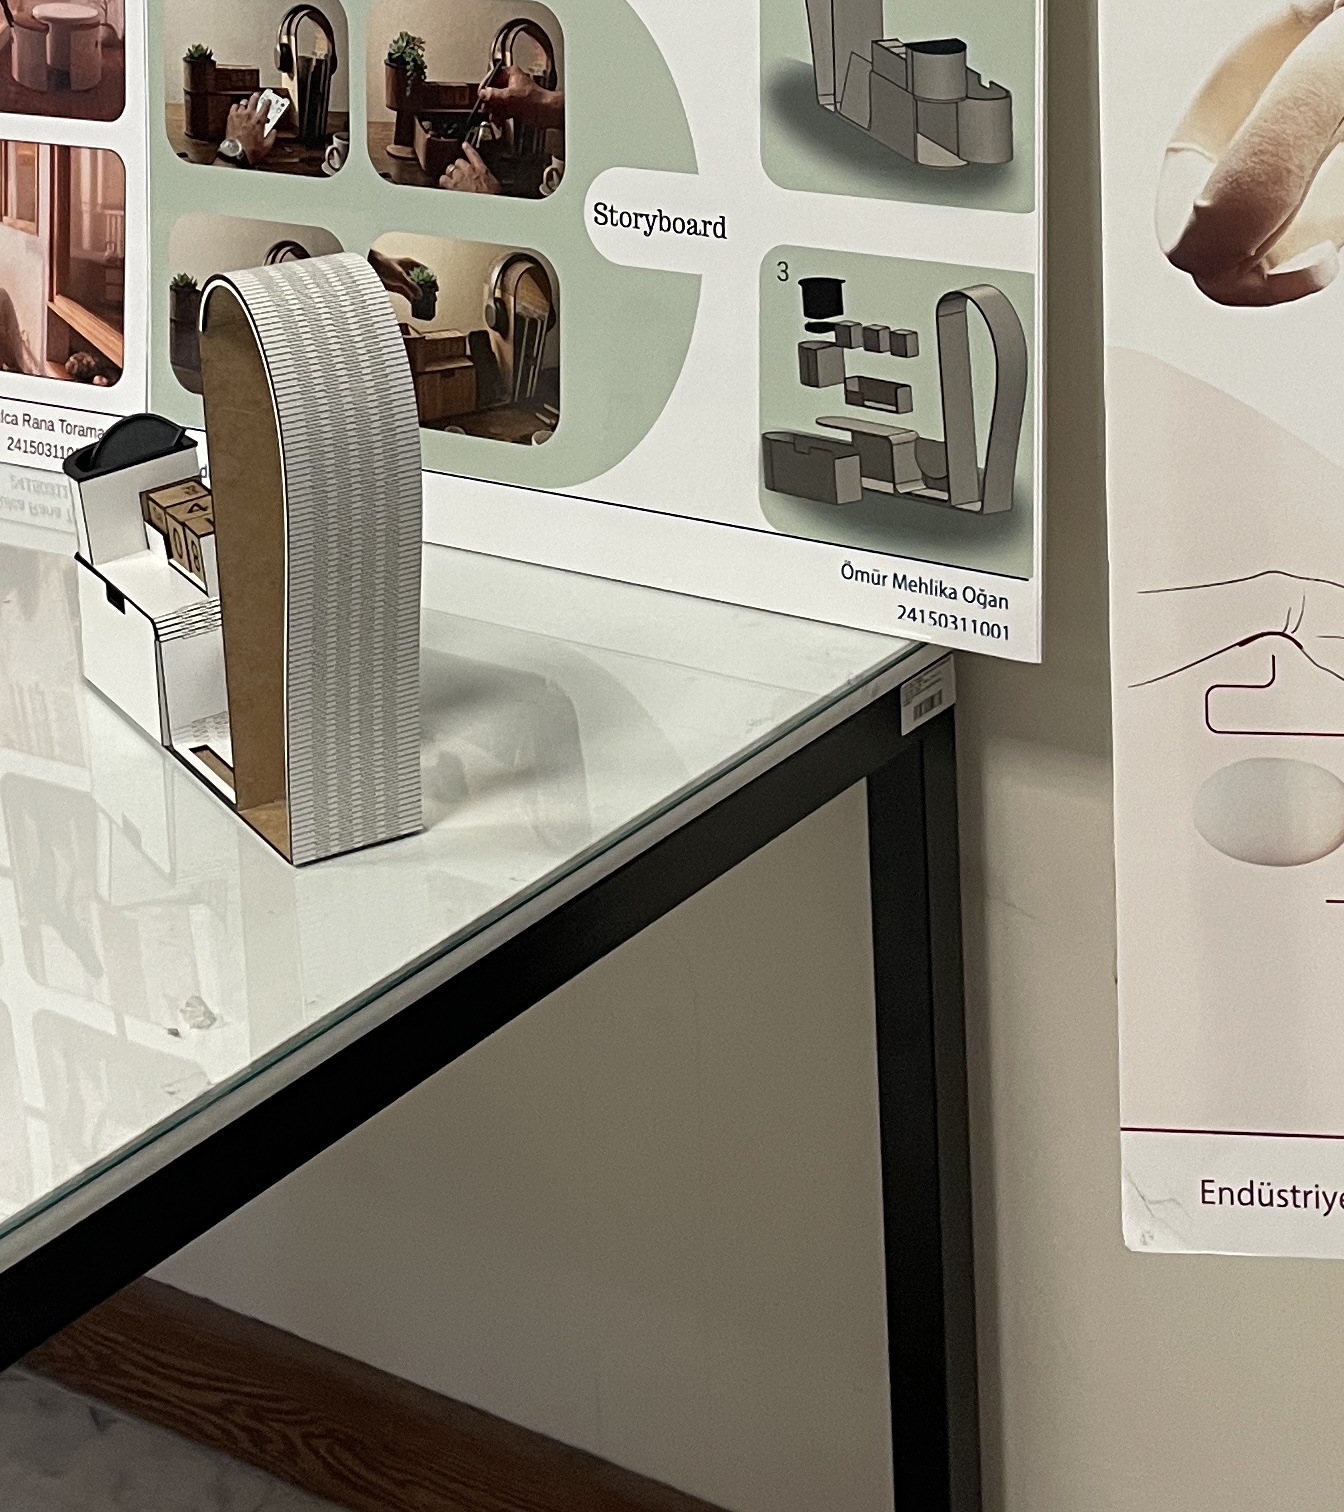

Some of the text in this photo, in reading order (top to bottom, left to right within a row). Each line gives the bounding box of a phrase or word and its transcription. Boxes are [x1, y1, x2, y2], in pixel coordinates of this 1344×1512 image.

[593, 202, 728, 240] Storyboard
[776, 261, 789, 282] 3
[22, 413, 55, 432] Rana
[841, 560, 1009, 610] Ömür Mehlika Oğan
[897, 605, 1009, 641] 24150311001
